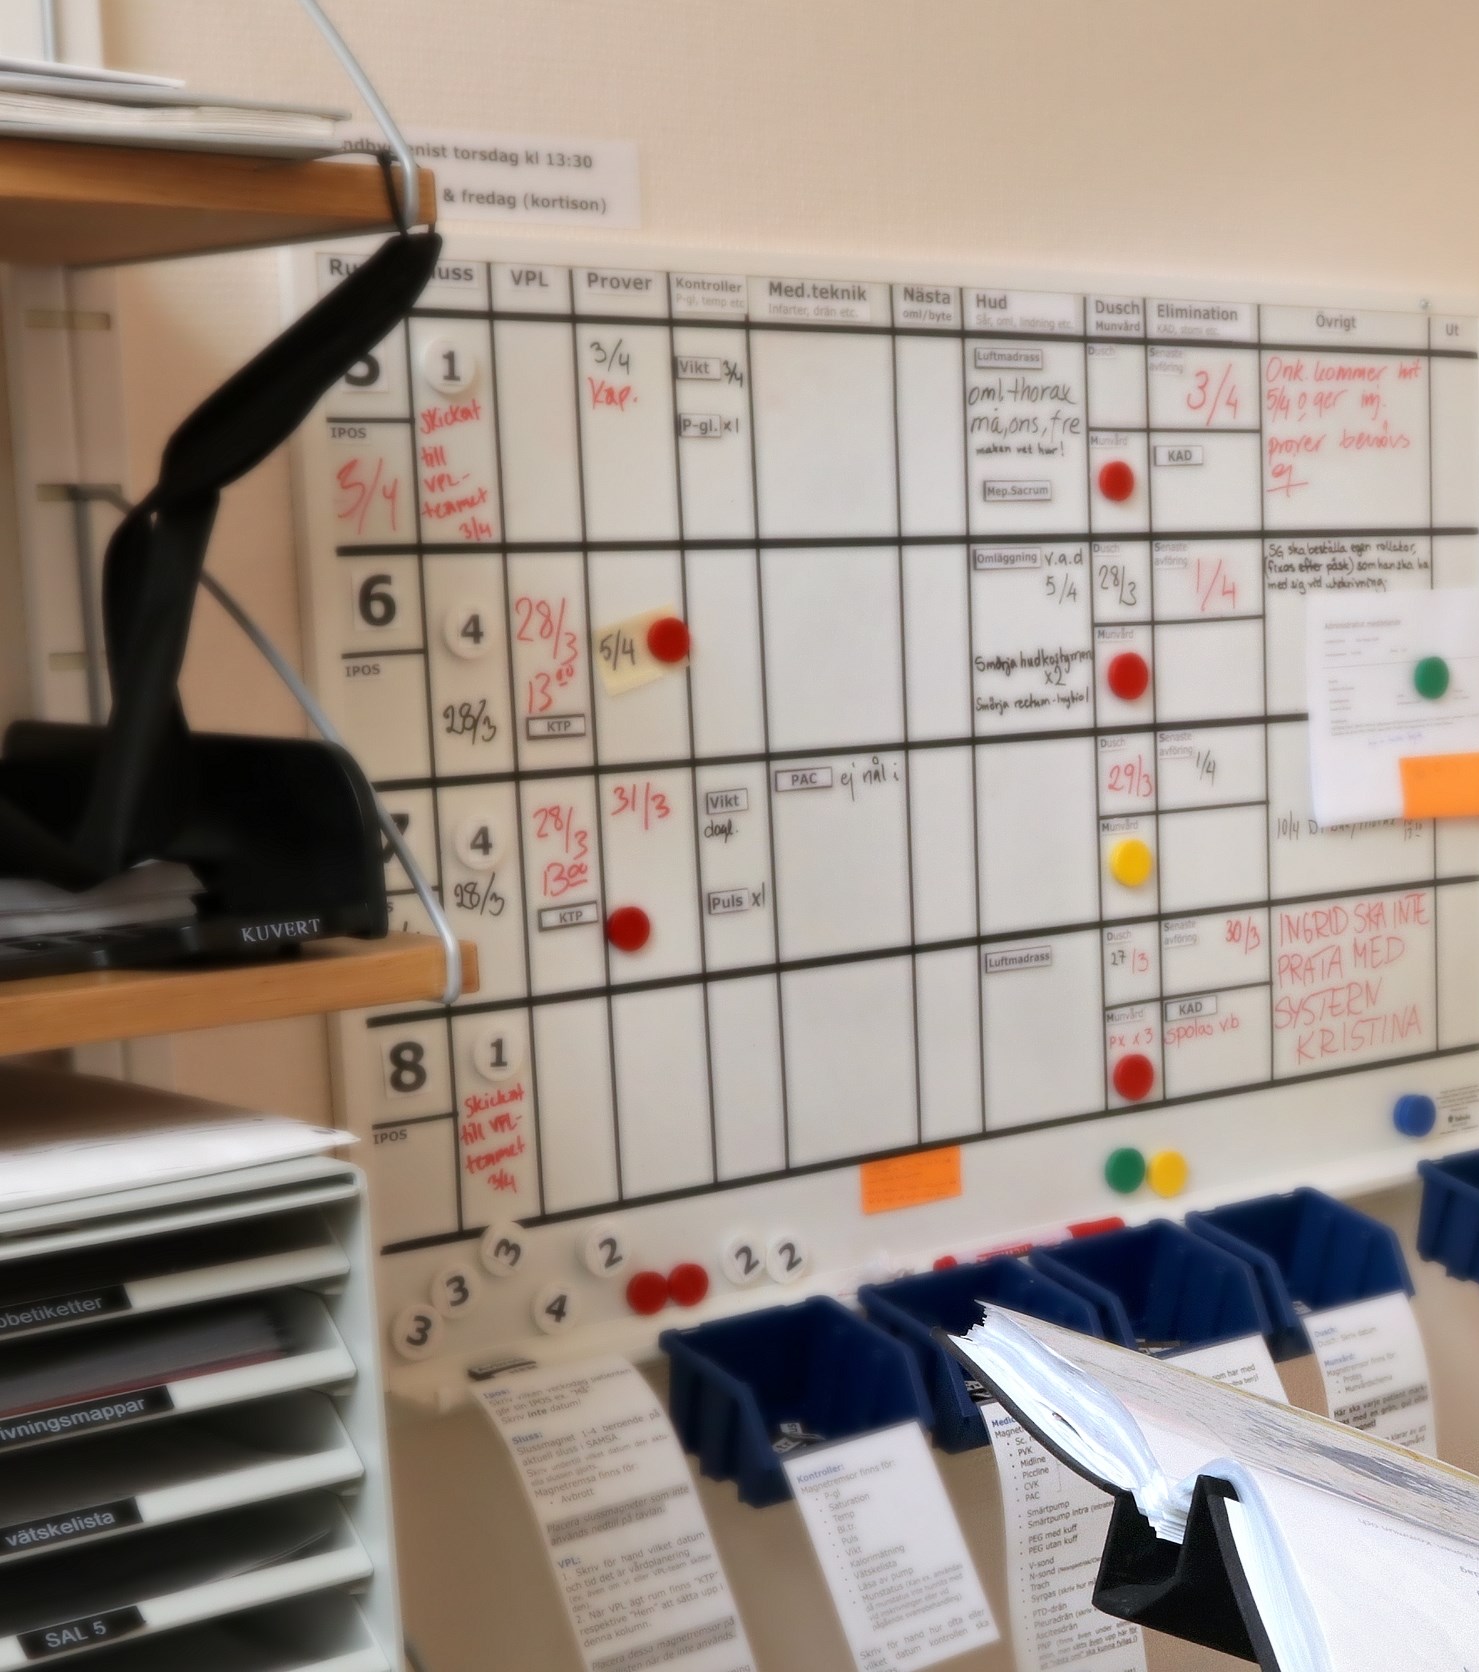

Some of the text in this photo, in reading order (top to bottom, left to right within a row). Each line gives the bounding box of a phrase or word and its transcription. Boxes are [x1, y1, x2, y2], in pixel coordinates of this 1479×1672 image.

[453, 147, 593, 169] torsdag kl 13:30
[443, 188, 607, 214] & fredag (kortison)
[511, 270, 549, 288] VPL
[587, 273, 653, 291] Prover
[675, 277, 743, 293] Kontroller
[768, 281, 867, 302] Med.teknik
[903, 286, 951, 304] Nästa
[976, 294, 1008, 310] Hud
[1096, 300, 1140, 315] Dusch
[902, 308, 953, 323] oml/byte
[1157, 304, 1239, 321] Elimination
[1315, 313, 1357, 331] Övrigt
[1096, 321, 1141, 332] Munvård
[1445, 324, 1460, 337] Ut
[441, 350, 461, 382] 1
[590, 338, 630, 376] 3/4
[977, 350, 1040, 363] Luftmadrass
[680, 360, 710, 374] Vikt
[1186, 363, 1239, 427] 3/4
[331, 427, 367, 439] IPOS
[682, 418, 719, 434] P-gl.
[1167, 450, 1193, 461] KAD
[977, 552, 1038, 566] Omläggning
[1045, 573, 1078, 605] 5/4
[1098, 563, 1137, 607] 28/3
[358, 574, 397, 627] 6
[460, 613, 484, 645] 4
[514, 597, 579, 666] 28/3
[599, 628, 636, 671] 5/4
[345, 664, 381, 678] IPOS
[442, 698, 497, 745] 28/3
[547, 720, 572, 733] KTP
[791, 772, 818, 786] PAC
[1107, 754, 1154, 798] 29/3
[610, 782, 671, 831] 31/3
[710, 796, 740, 809] Vikt
[470, 826, 493, 856] 4
[533, 805, 588, 860] 28/3
[454, 871, 505, 917] 28/3
[712, 896, 743, 911] Puls
[559, 911, 583, 923] KTP
[1279, 892, 1431, 948] INGRID SKA INTE
[241, 918, 321, 944] KUVERT
[988, 951, 1051, 969] Luftmadrass
[1277, 935, 1406, 988] PRATA MED
[1178, 1002, 1203, 1016] KAD
[1274, 976, 1383, 1030] SYSTERN
[1296, 1003, 1423, 1065] KRISTINA
[489, 1038, 508, 1068] 1
[389, 1041, 428, 1093] 8
[373, 1129, 408, 1145] IPOS
[494, 1238, 521, 1268] 3
[598, 1237, 624, 1269] 2
[734, 1245, 760, 1275] 2
[778, 1242, 802, 1271] 2
[446, 1275, 470, 1308] 3
[545, 1293, 568, 1323] 4
[406, 1315, 433, 1347] 3
[0, 1397, 146, 1441] ivningsmappar
[512, 1431, 544, 1446] Sluss:
[1018, 1447, 1033, 1457] PVK
[1020, 1456, 1047, 1468] Midline
[796, 1464, 845, 1484] Kontroller:
[801, 1472, 858, 1495] Magnetremsor
[859, 1465, 880, 1476] finns
[1022, 1466, 1050, 1480] Piccline
[1024, 1480, 1040, 1491] CVK
[828, 1492, 870, 1512] Saturation
[1025, 1491, 1041, 1501] PAC
[832, 1511, 855, 1523] Temp
[1027, 1501, 1070, 1518] Smärtpump
[5, 1510, 117, 1548] vätskelista
[1028, 1511, 1071, 1529] Smärtpump
[841, 1534, 859, 1546] Puls
[1028, 1523, 1078, 1544] PEG med kuff
[1028, 1534, 1078, 1555] PEG utan kuff
[1029, 1556, 1055, 1570] V-sond
[1030, 1567, 1056, 1580] N-sond
[1030, 1580, 1050, 1592] Trach
[46, 1620, 107, 1649] SAL 5
